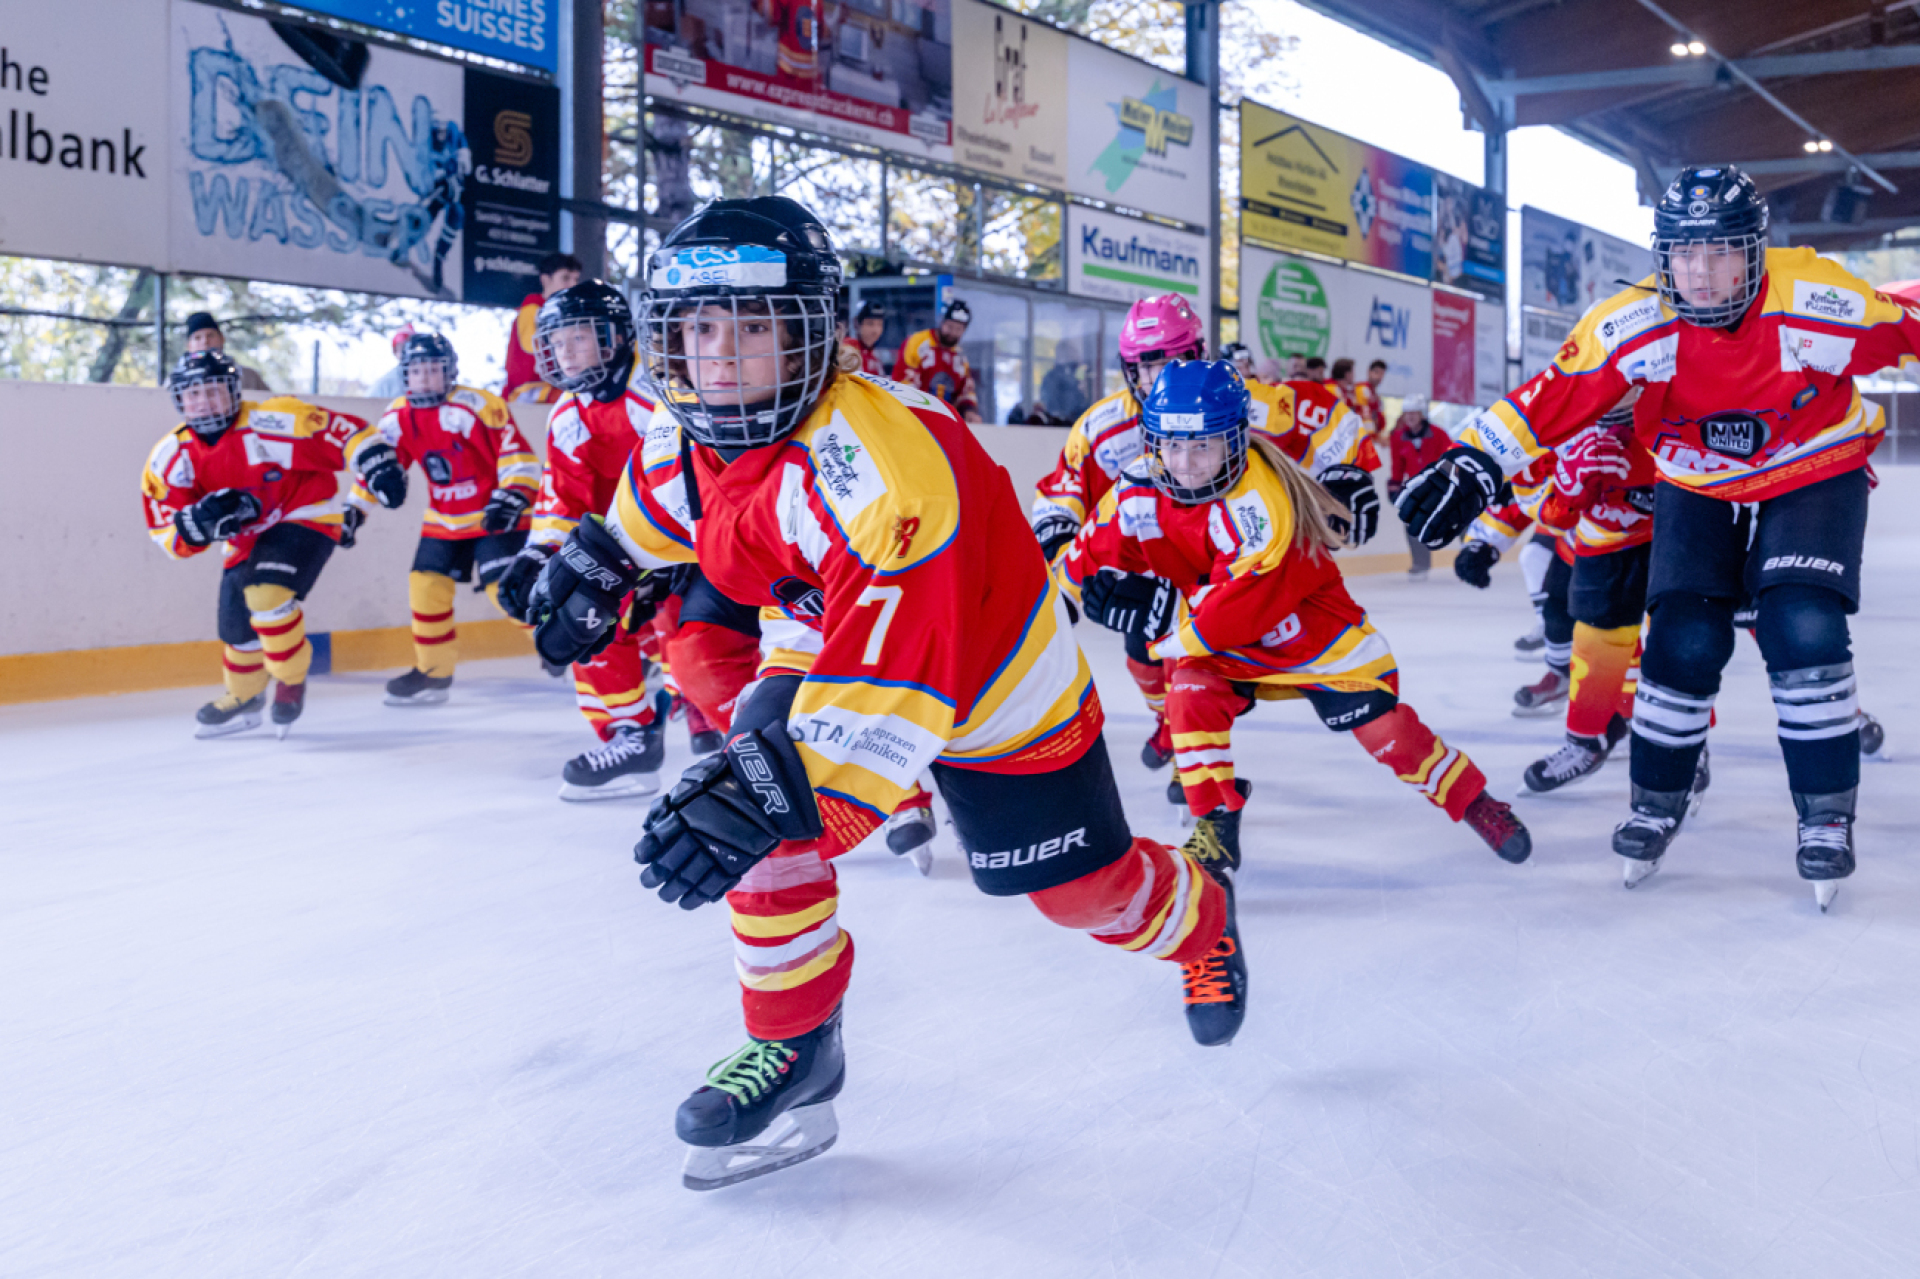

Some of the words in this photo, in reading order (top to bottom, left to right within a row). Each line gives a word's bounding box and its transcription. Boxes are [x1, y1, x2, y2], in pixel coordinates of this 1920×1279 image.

[437, 0, 546, 51] SUISSES
[0, 108, 147, 179] lbank
[189, 46, 434, 200] DEIN
[491, 166, 551, 194] Schlatter
[189, 169, 433, 265] WASSER
[1081, 222, 1200, 279] Kaufmann
[1709, 436, 1750, 450] UNITED
[1710, 423, 1751, 441] NW
[1761, 552, 1846, 577] BAUER
[857, 585, 903, 666] 7
[1325, 703, 1371, 727] CCM
[970, 826, 1091, 869] BAUER
